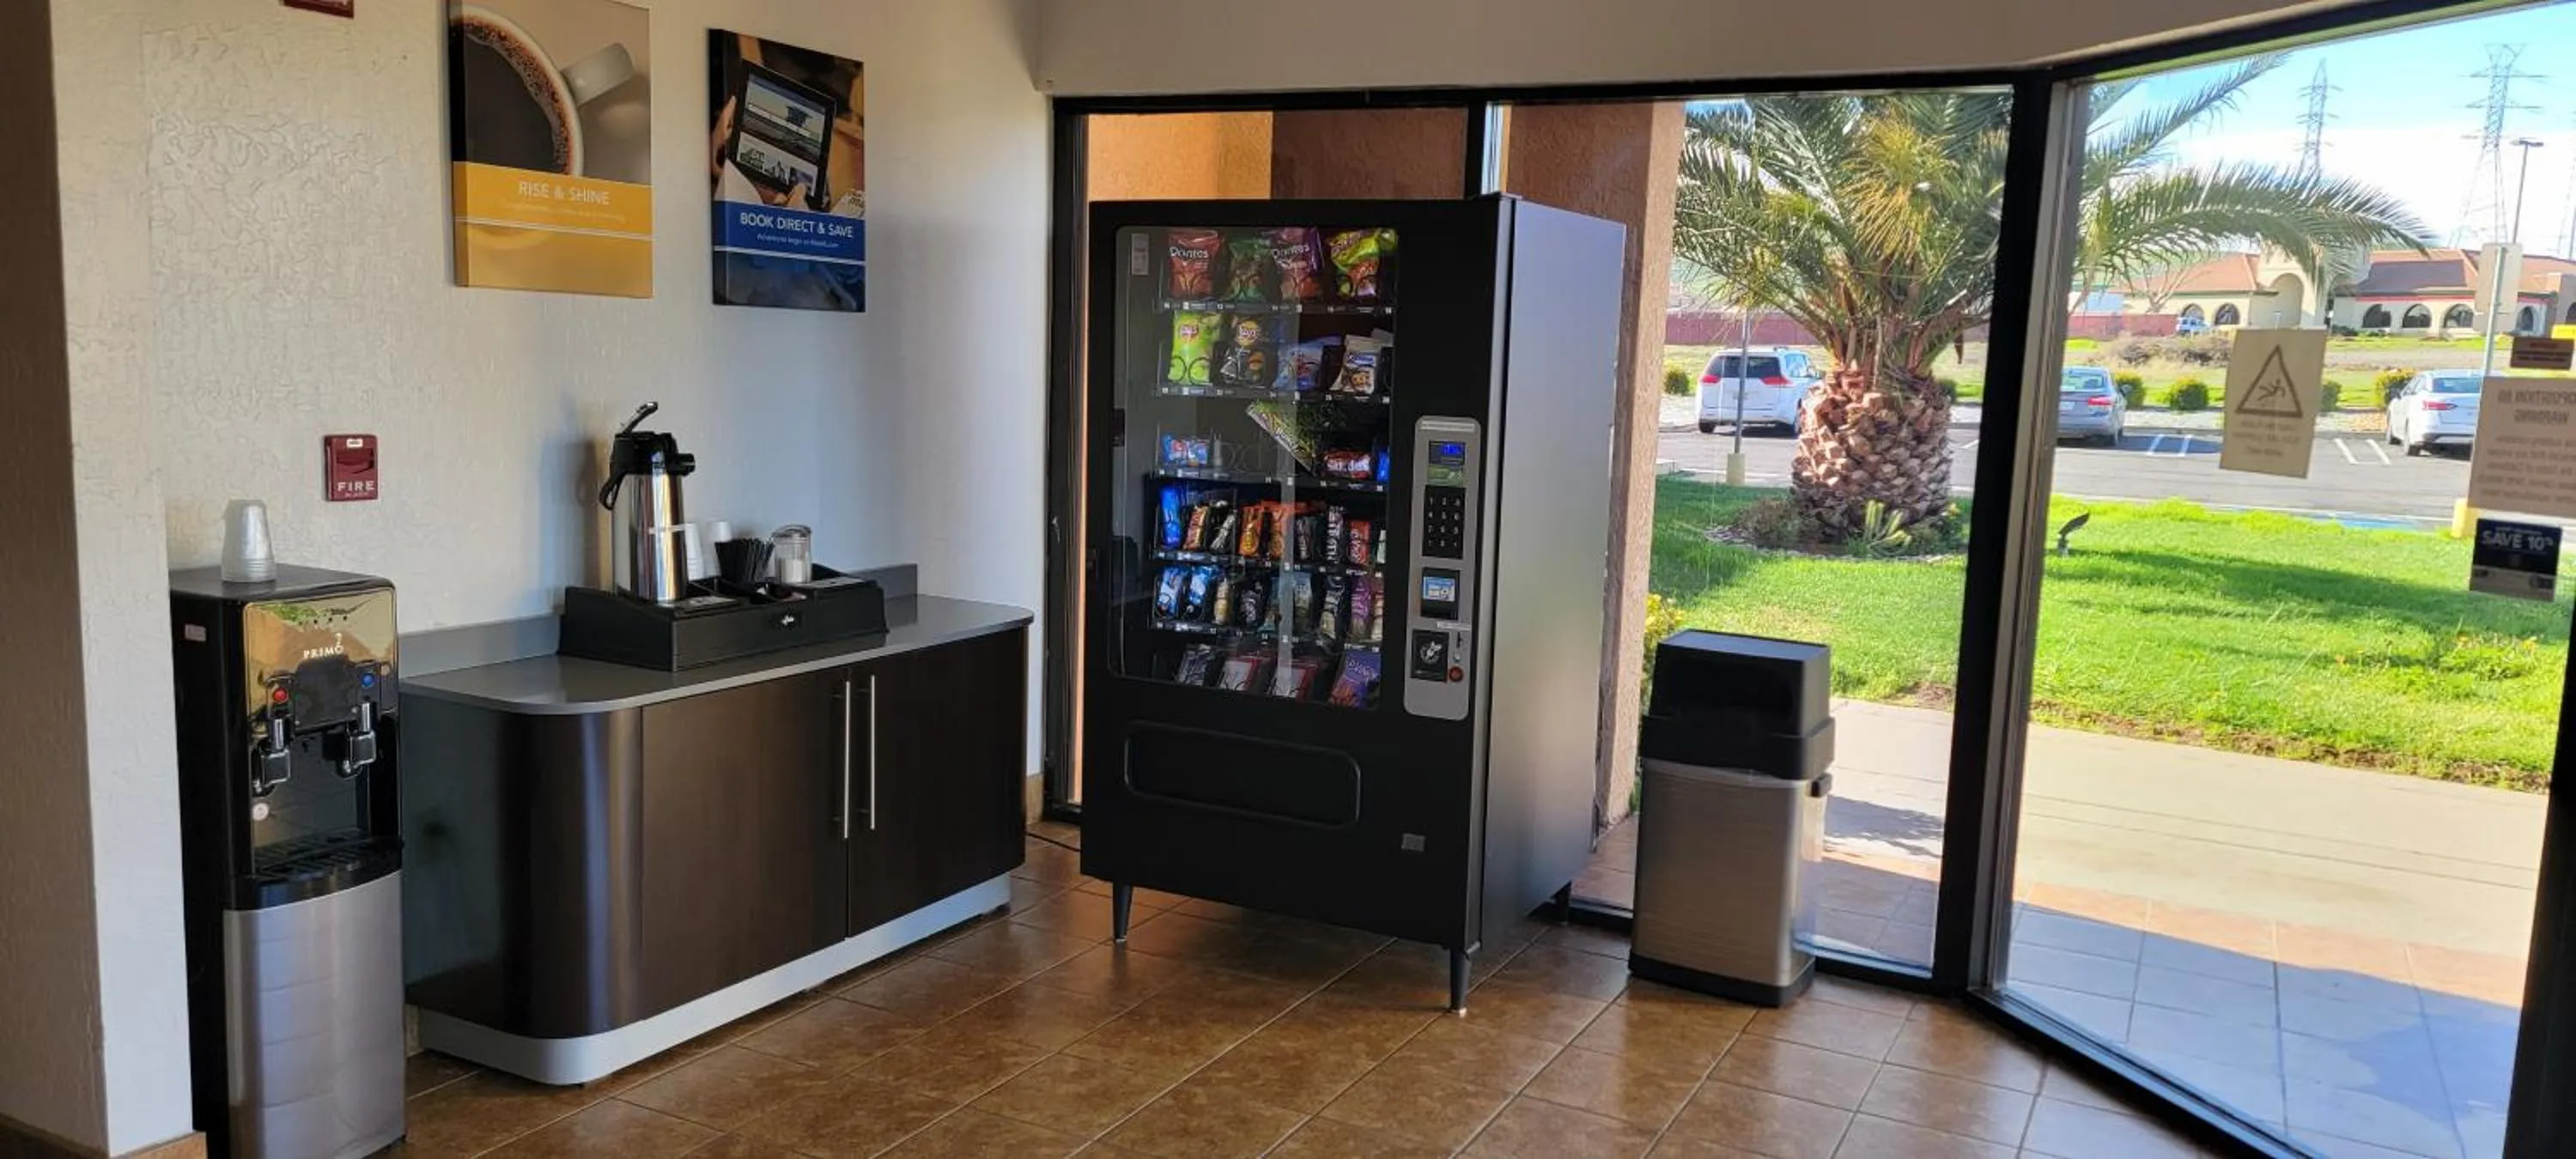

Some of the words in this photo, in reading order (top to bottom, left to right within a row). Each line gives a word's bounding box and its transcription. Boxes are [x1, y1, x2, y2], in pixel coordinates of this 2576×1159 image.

[519, 181, 550, 198] RISE
[554, 185, 565, 200] &
[569, 187, 611, 205] SHINE
[740, 212, 773, 228] BOOK
[777, 217, 814, 233] DIRECT
[817, 222, 825, 234] &
[828, 224, 853, 238] SAVE
[1169, 246, 1209, 258] Doritos
[337, 481, 375, 492] FIRE
[2482, 530, 2522, 549] SAVE
[303, 646, 344, 659] PRIMO
